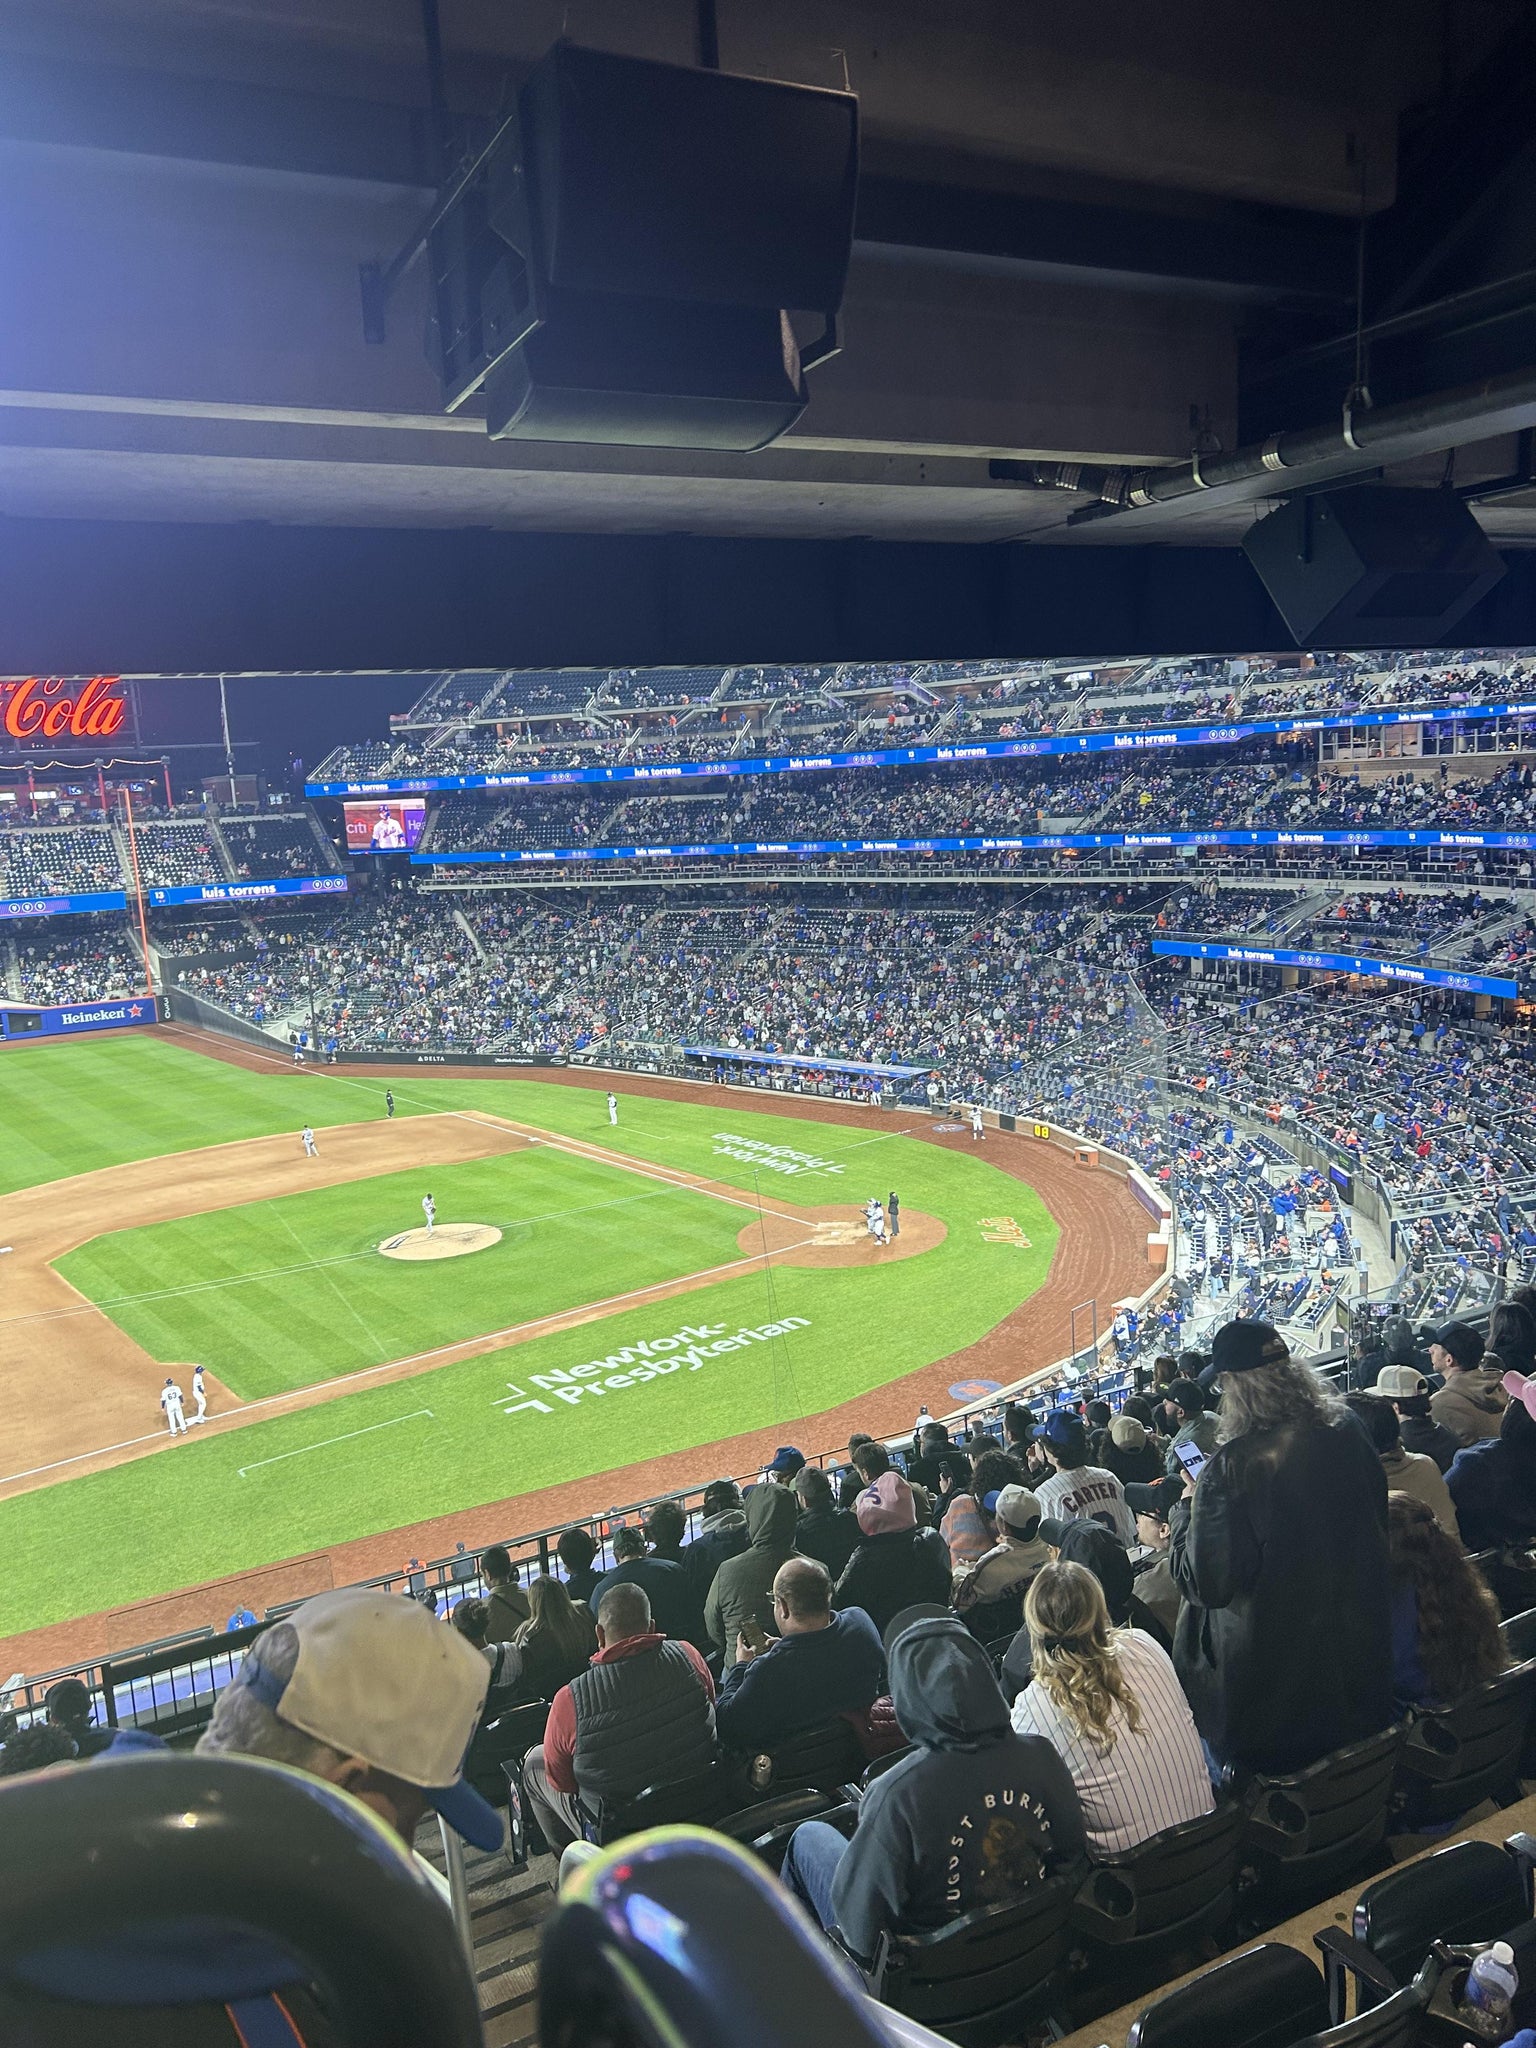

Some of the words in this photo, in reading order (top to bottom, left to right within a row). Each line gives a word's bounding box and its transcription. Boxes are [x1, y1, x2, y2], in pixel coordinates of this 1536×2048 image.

[1114, 736, 1133, 746] luis
[1135, 732, 1178, 744] torrens
[937, 748, 953, 758] luis
[954, 747, 987, 757] torrens
[789, 758, 803, 768] luis
[634, 768, 649, 777] luis
[346, 822, 367, 834] citi
[1124, 835, 1140, 844] luis
[1141, 835, 1171, 843] torrens
[1278, 833, 1292, 842] luis
[1440, 833, 1454, 843] luis
[202, 887, 226, 899] luis
[227, 883, 276, 897] torrens
[1227, 948, 1243, 958] luis
[1244, 950, 1275, 961] torrens
[1380, 963, 1395, 975] luis
[163, 997, 172, 1019] 330
[61, 1008, 125, 1025] Heineken
[552, 1316, 812, 1405] Presbyterian
[167, 1391, 177, 1401] 63
[1062, 1482, 1118, 1513] CARTER
[984, 1789, 1050, 1832] BURNS
